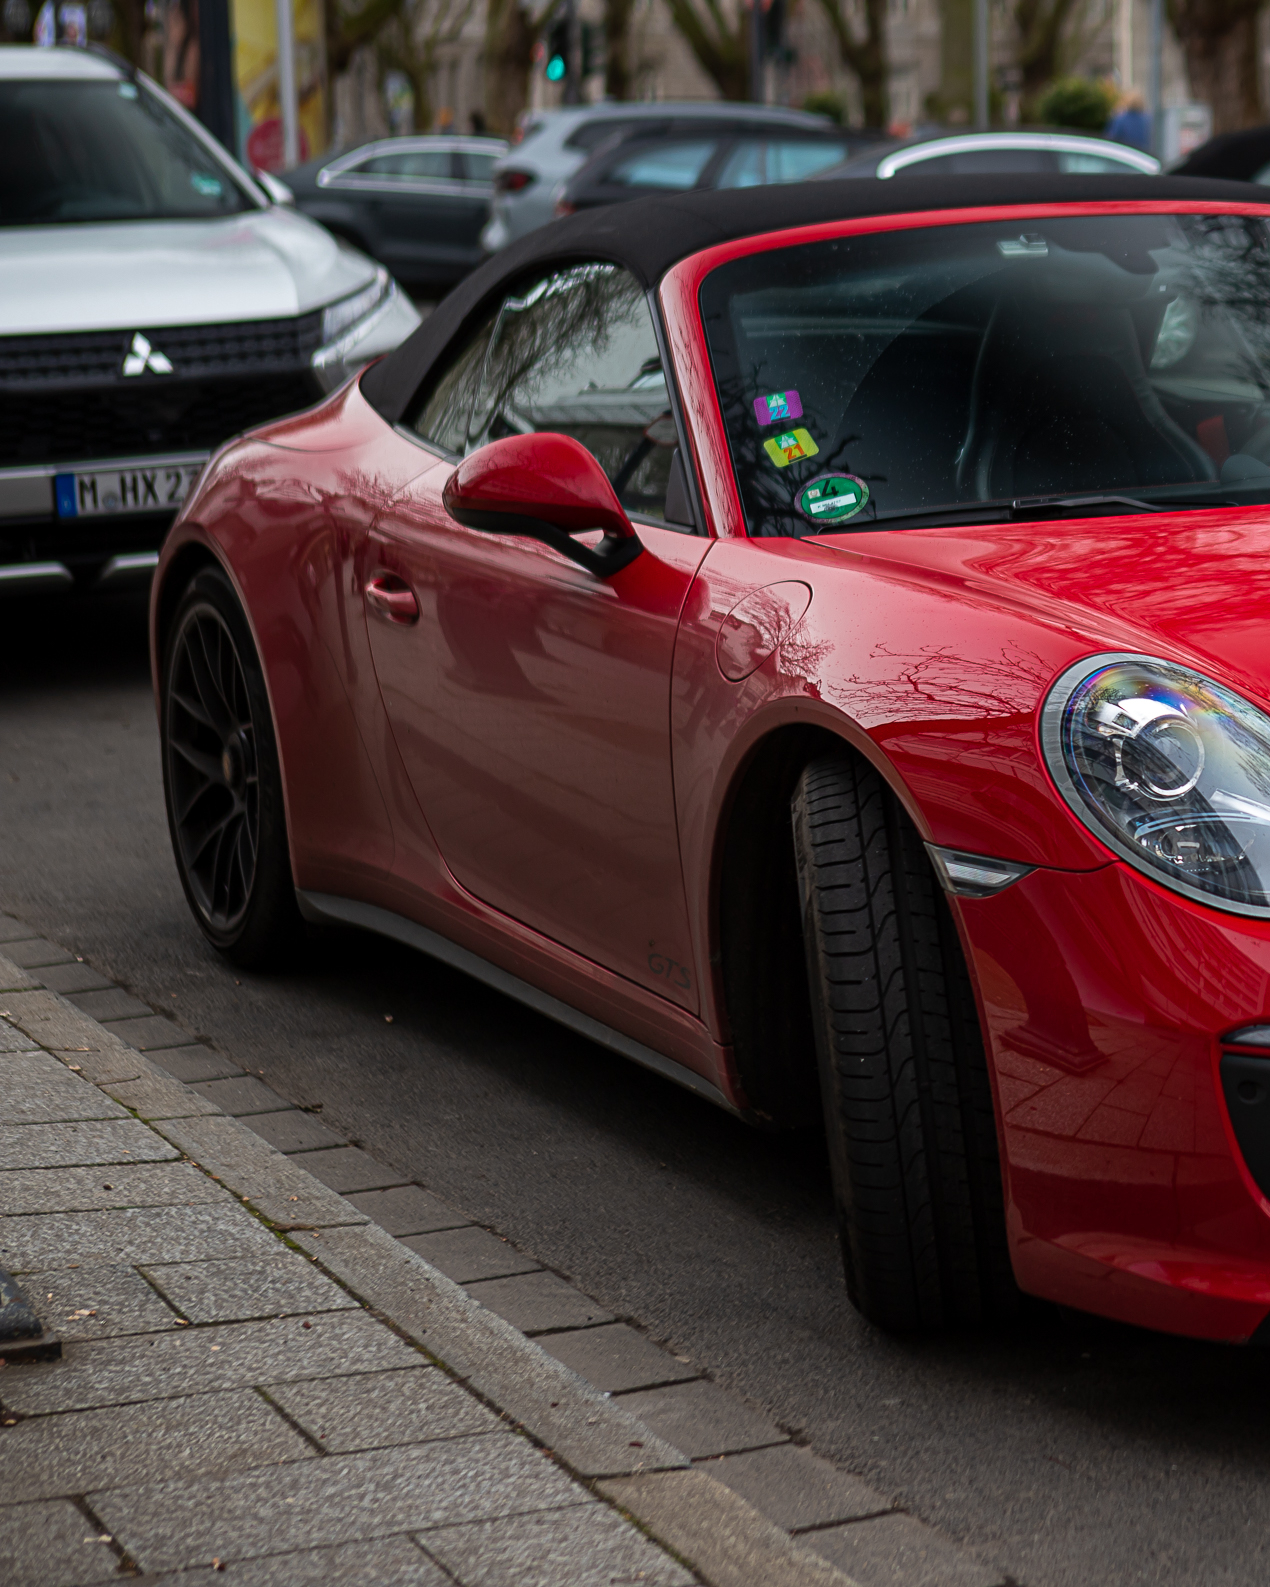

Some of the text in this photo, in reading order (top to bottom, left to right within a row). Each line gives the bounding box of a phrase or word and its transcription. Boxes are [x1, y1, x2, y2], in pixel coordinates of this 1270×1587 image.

[768, 404, 791, 421] 22
[783, 443, 805, 461] 21
[78, 476, 99, 510] M
[119, 470, 160, 507] HX
[821, 479, 839, 497] 4
[647, 953, 691, 990] GTS
